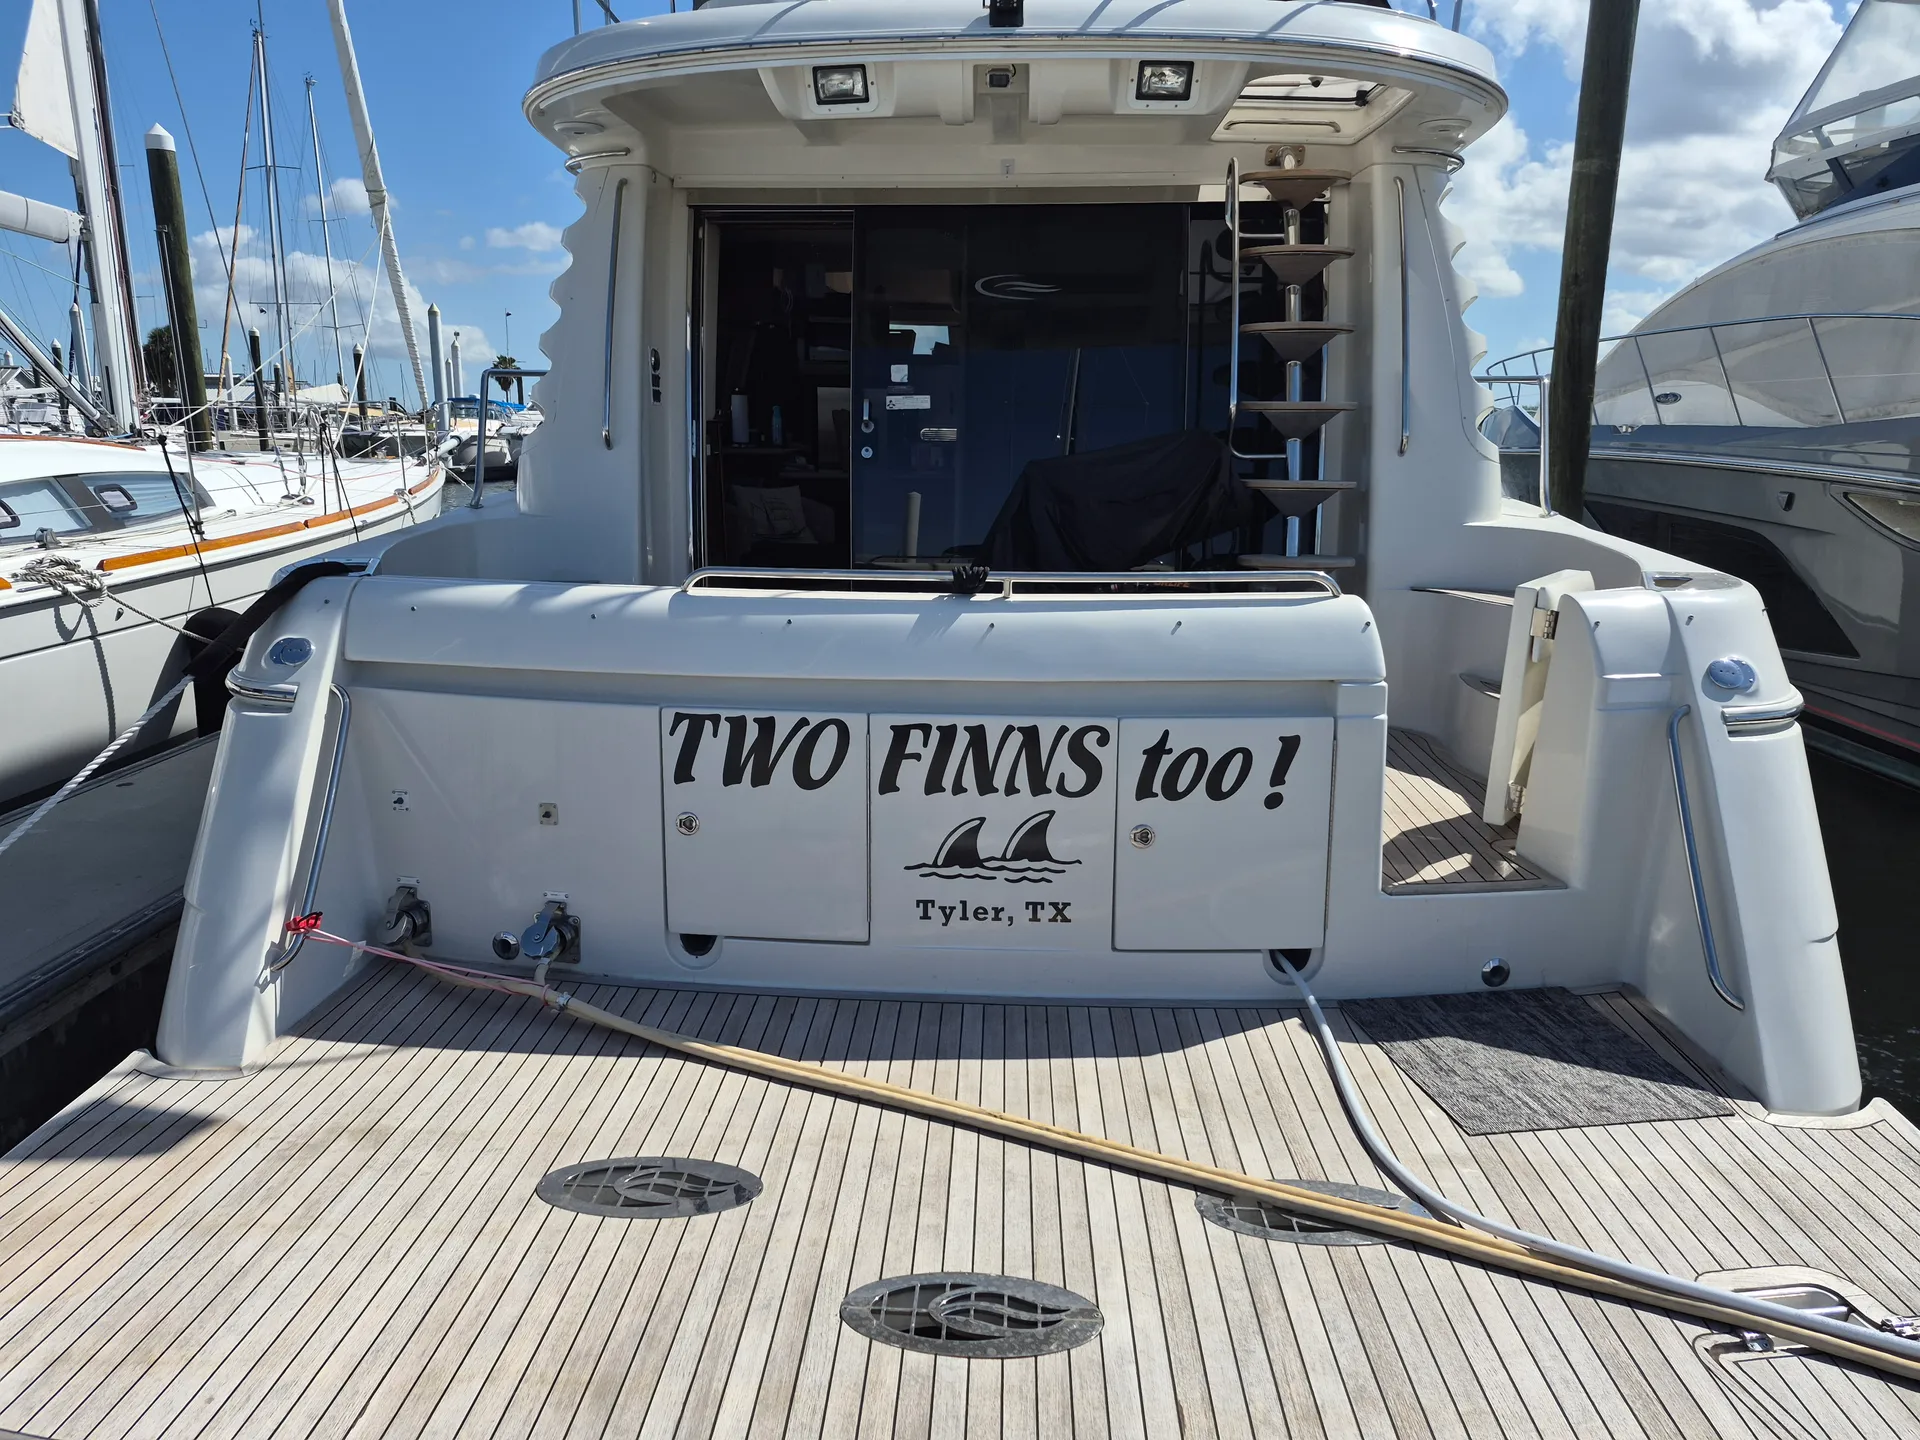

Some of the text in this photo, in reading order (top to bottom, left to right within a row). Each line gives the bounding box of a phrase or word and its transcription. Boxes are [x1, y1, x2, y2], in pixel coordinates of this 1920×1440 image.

[668, 711, 851, 791] TWO
[878, 722, 1111, 799] FINNS
[915, 899, 1072, 927] Tyler, TX
